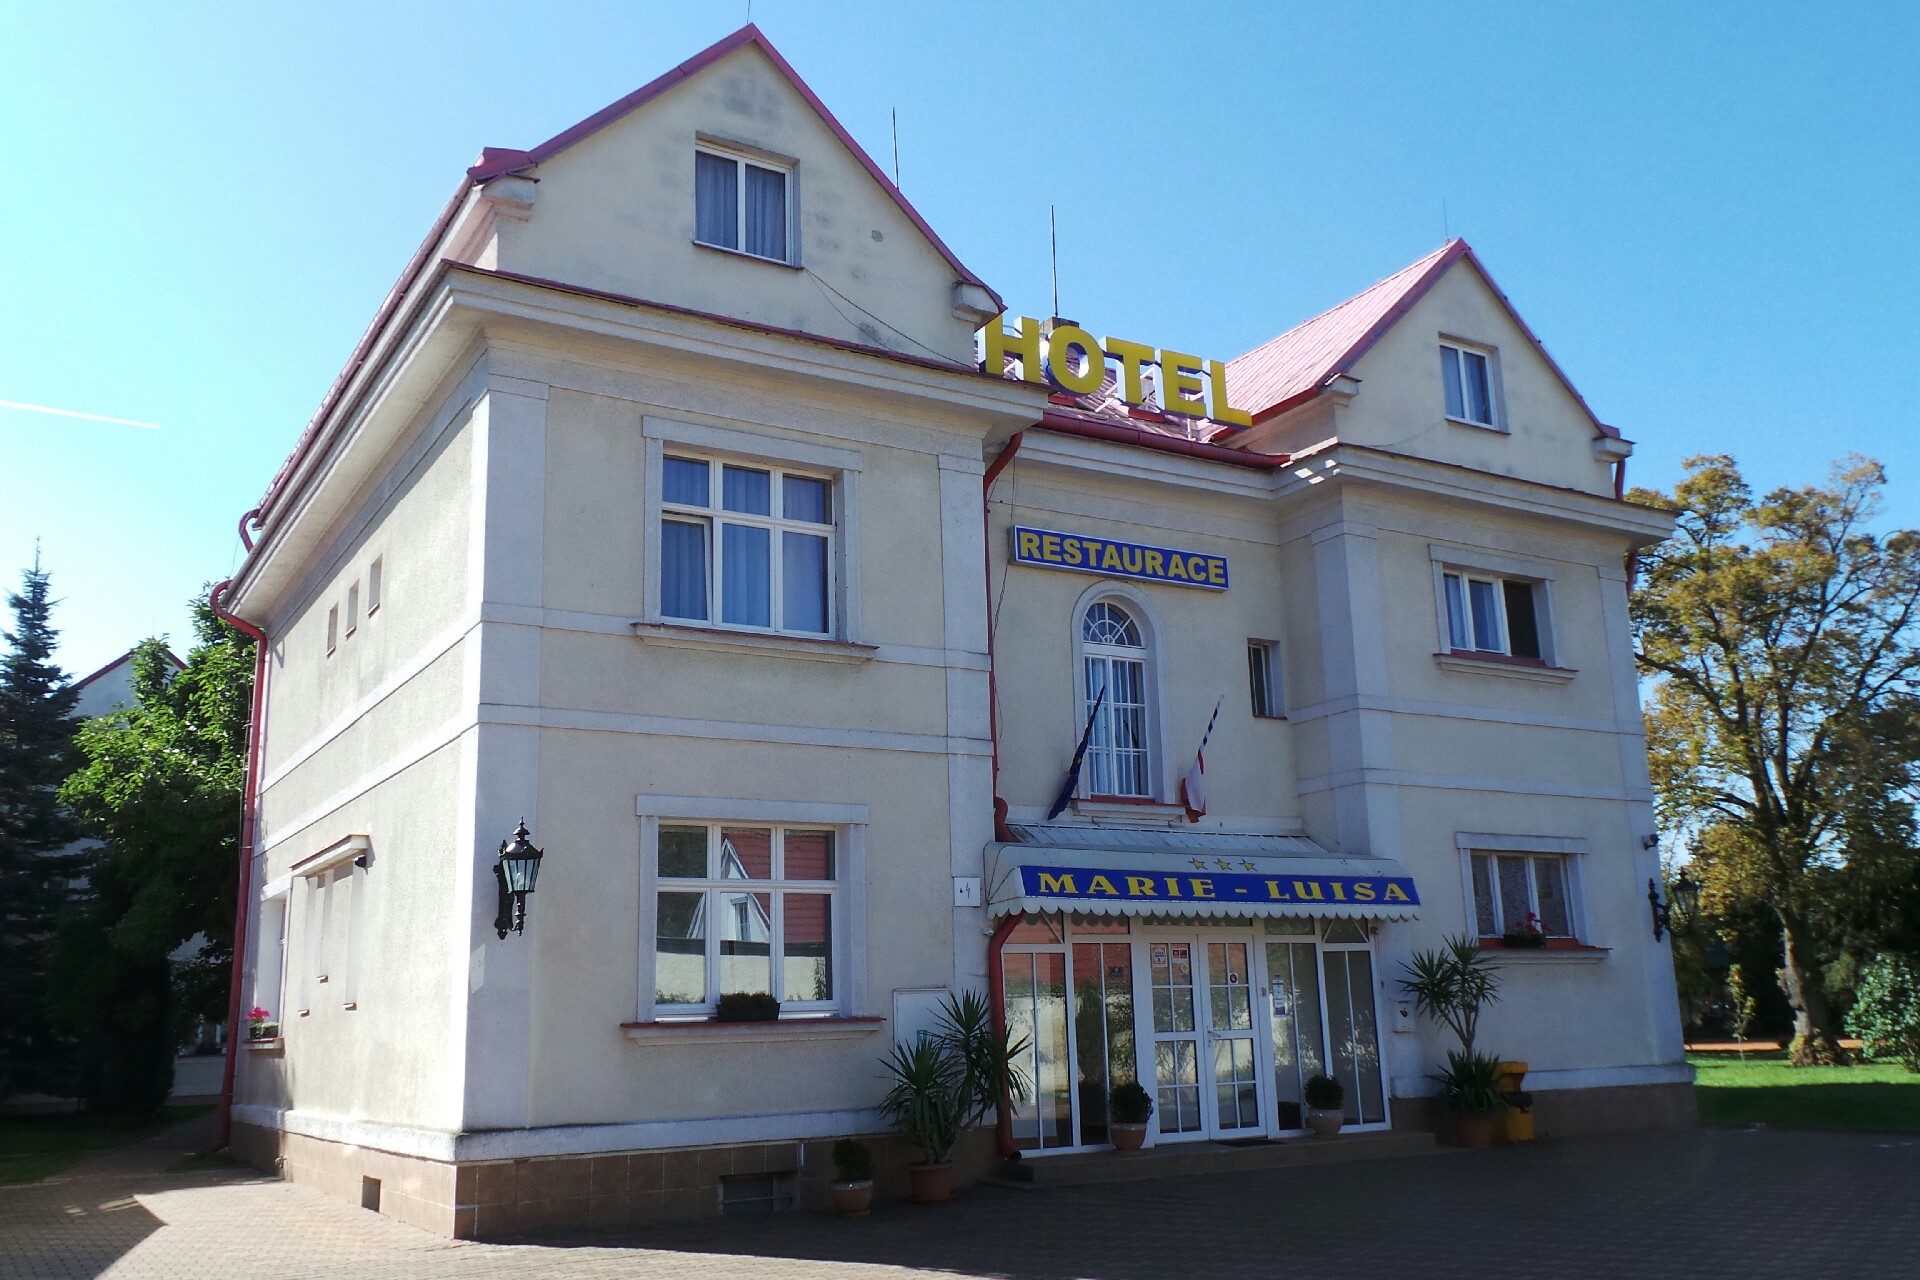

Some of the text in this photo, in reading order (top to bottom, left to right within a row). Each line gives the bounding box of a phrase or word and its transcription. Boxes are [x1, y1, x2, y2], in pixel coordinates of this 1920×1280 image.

[980, 314, 1253, 427] HOTEL
[1020, 531, 1226, 584] RESTAURACE
[1037, 872, 1216, 898] MARIE
[1265, 880, 1411, 901] LUISA
